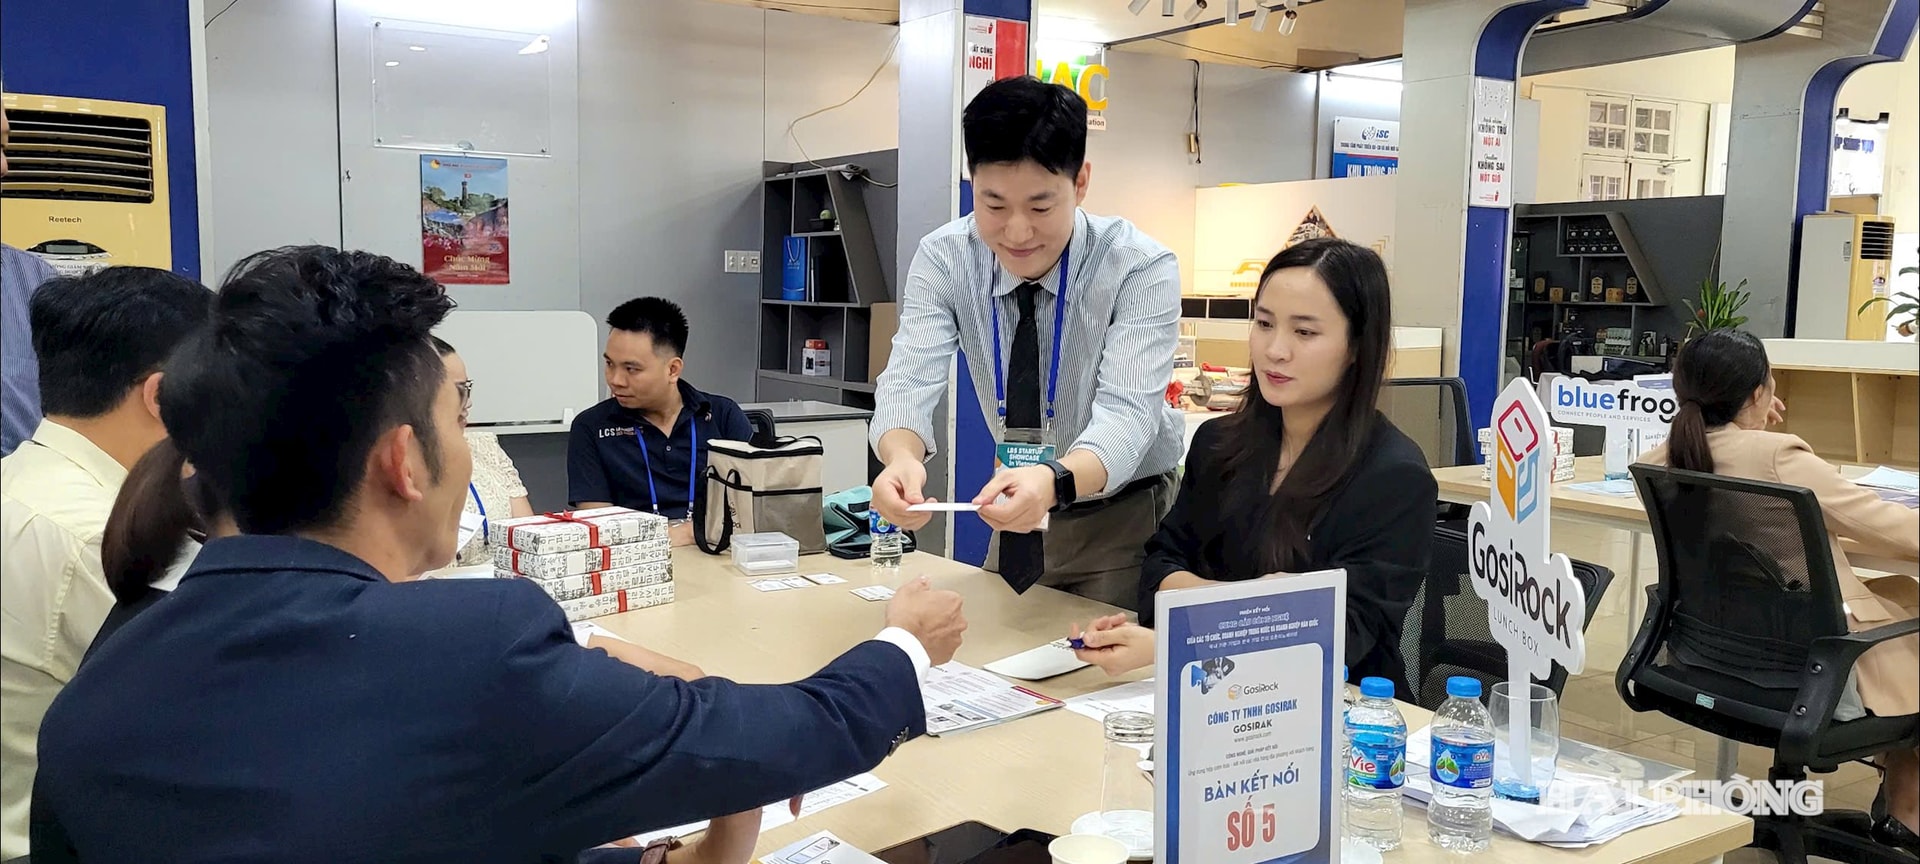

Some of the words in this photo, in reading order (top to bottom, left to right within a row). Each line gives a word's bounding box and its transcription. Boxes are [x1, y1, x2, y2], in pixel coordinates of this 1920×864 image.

[1472, 522, 1571, 650] GosiRock
[1493, 608, 1519, 639] LUNCH
[1521, 631, 1539, 656] BOX
[1243, 681, 1279, 696] GosiRock
[1207, 711, 1229, 726] CÔNG
[1231, 709, 1241, 722] TY
[1243, 705, 1263, 719] TNHH
[1265, 699, 1298, 715] GOSIRAK
[1233, 719, 1273, 734] GOSIRAK
[1350, 756, 1376, 773] Vie
[1204, 781, 1236, 802] BÀN
[1240, 769, 1269, 794] KẾT
[1273, 762, 1299, 787] NỐI
[1227, 795, 1255, 851] SỐ
[1262, 803, 1276, 843] 5
